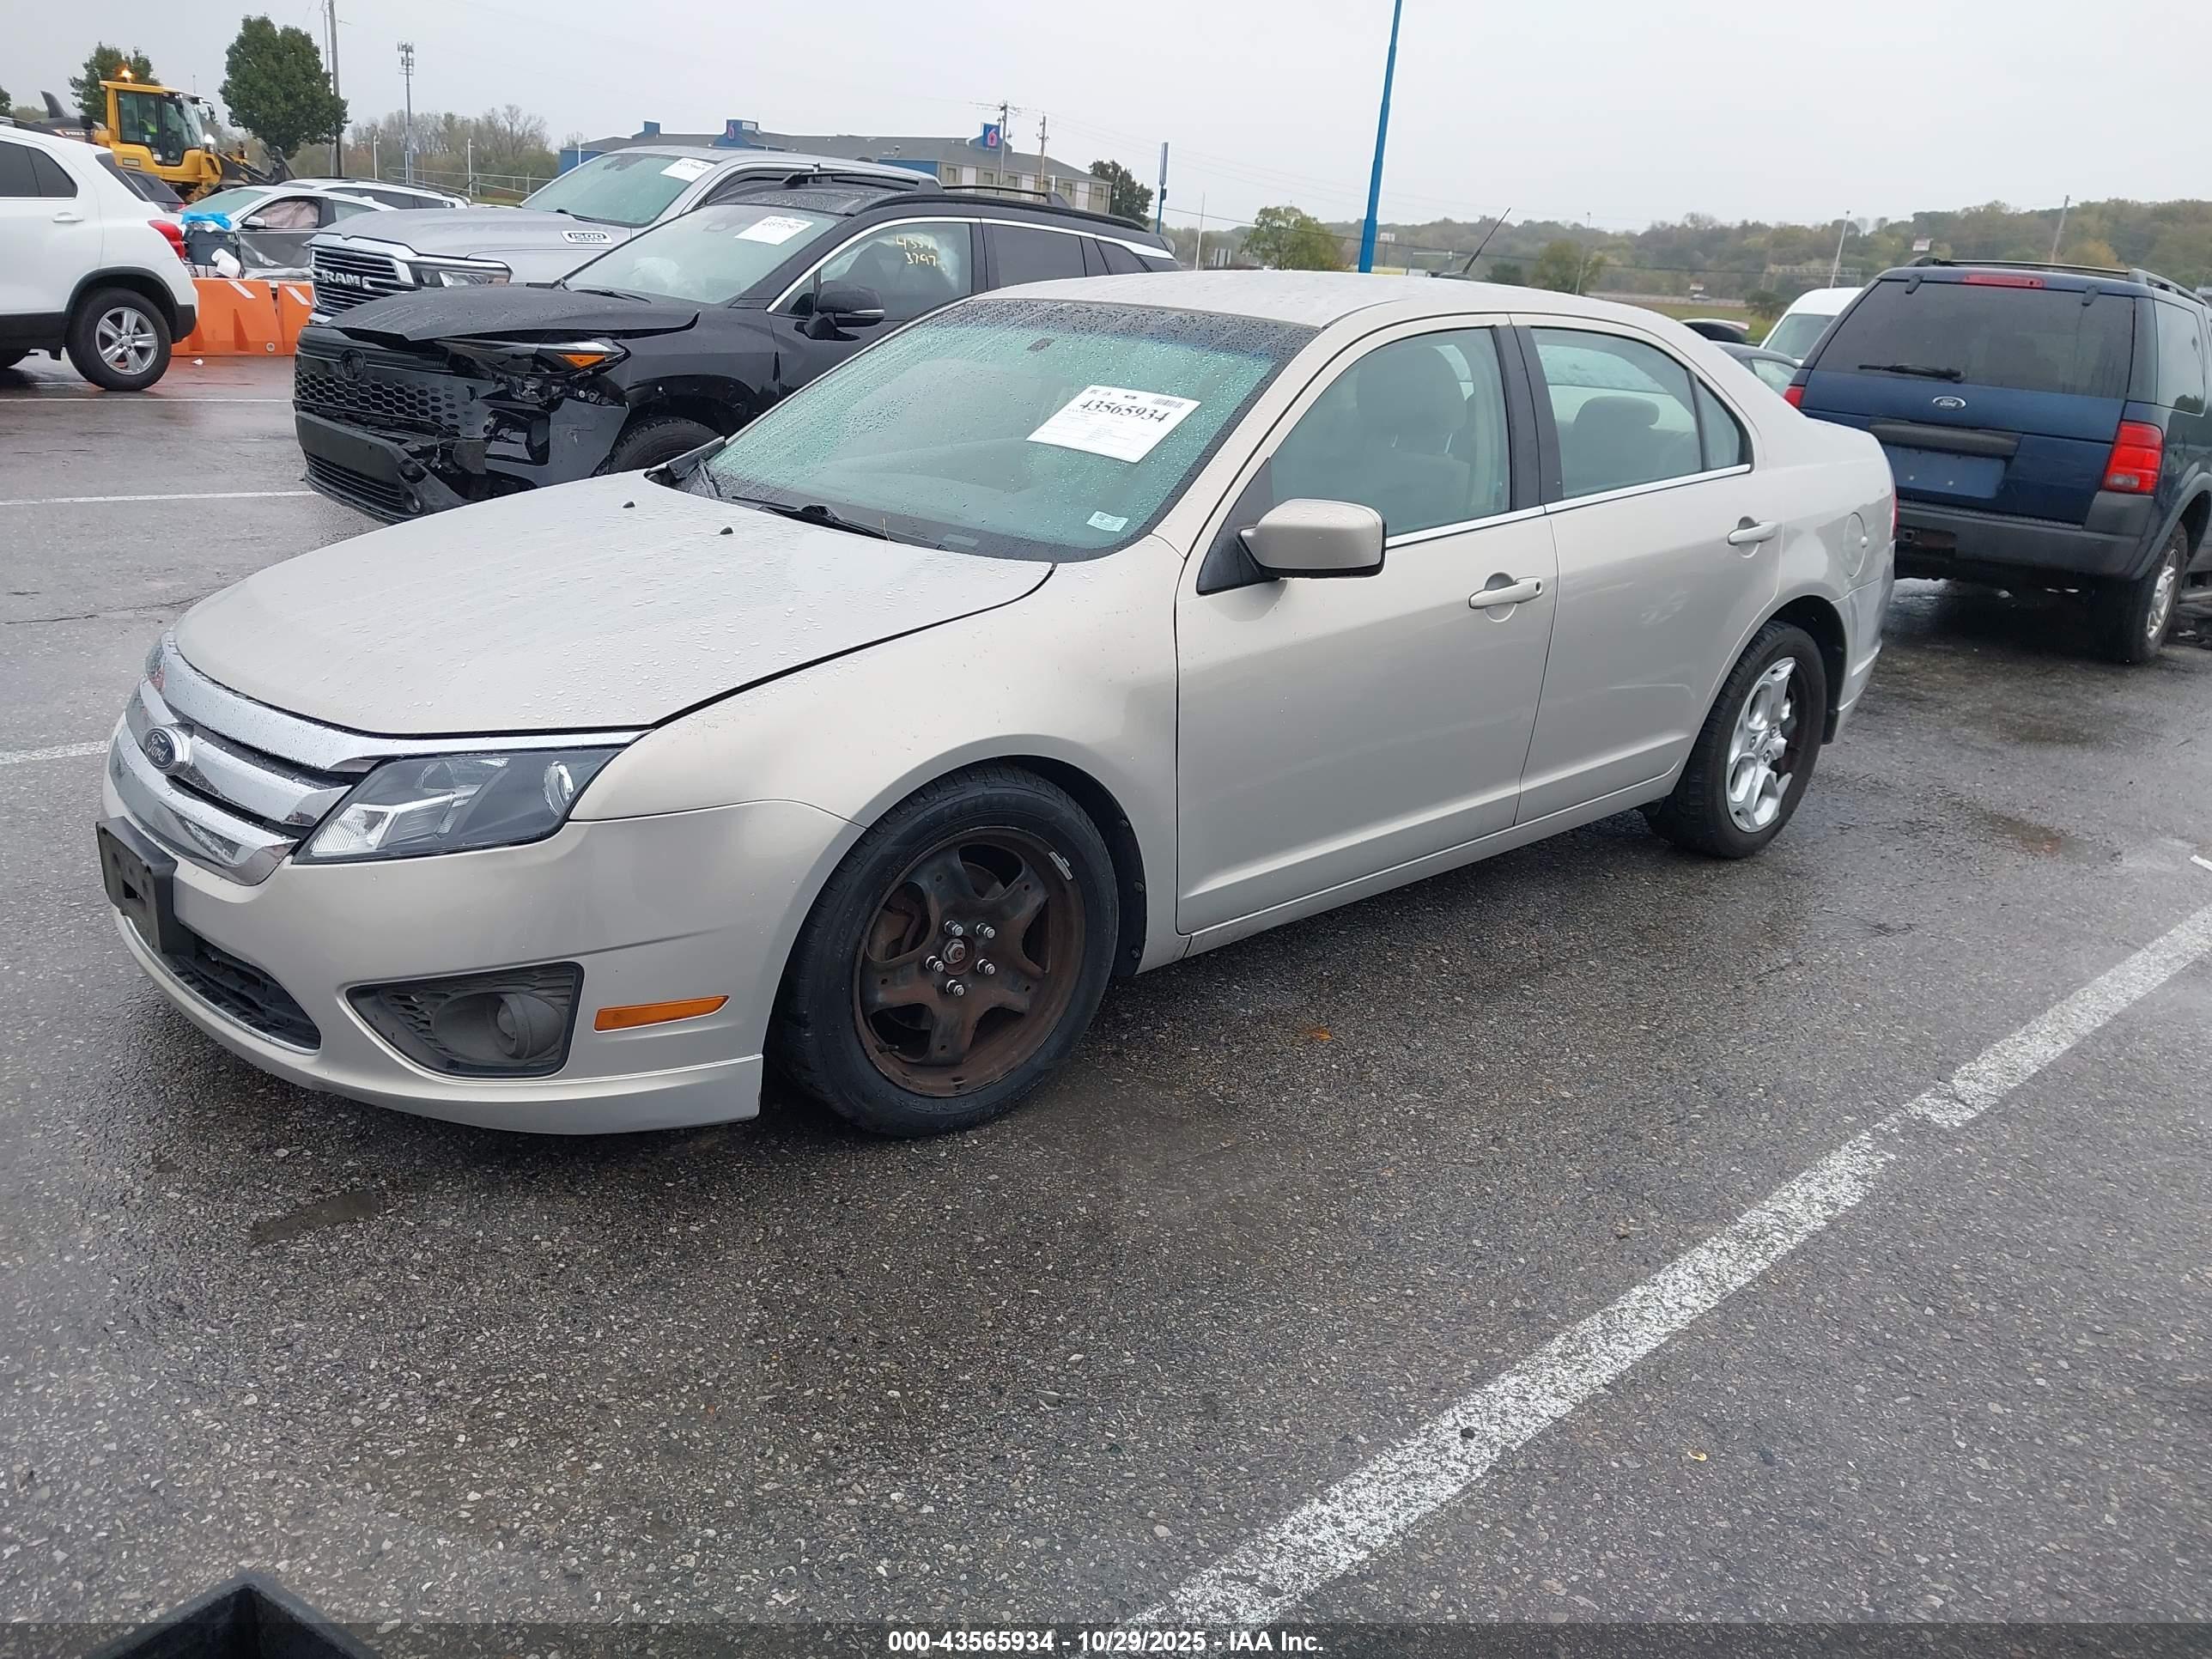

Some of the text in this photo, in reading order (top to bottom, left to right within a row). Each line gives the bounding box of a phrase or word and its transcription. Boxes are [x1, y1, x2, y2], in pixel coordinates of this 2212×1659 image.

[988, 127, 998, 146] 6
[905, 252, 936, 266] 3797
[322, 270, 361, 286] RAM
[1079, 399, 1170, 422] 43565934
[147, 732, 169, 763] Ford
